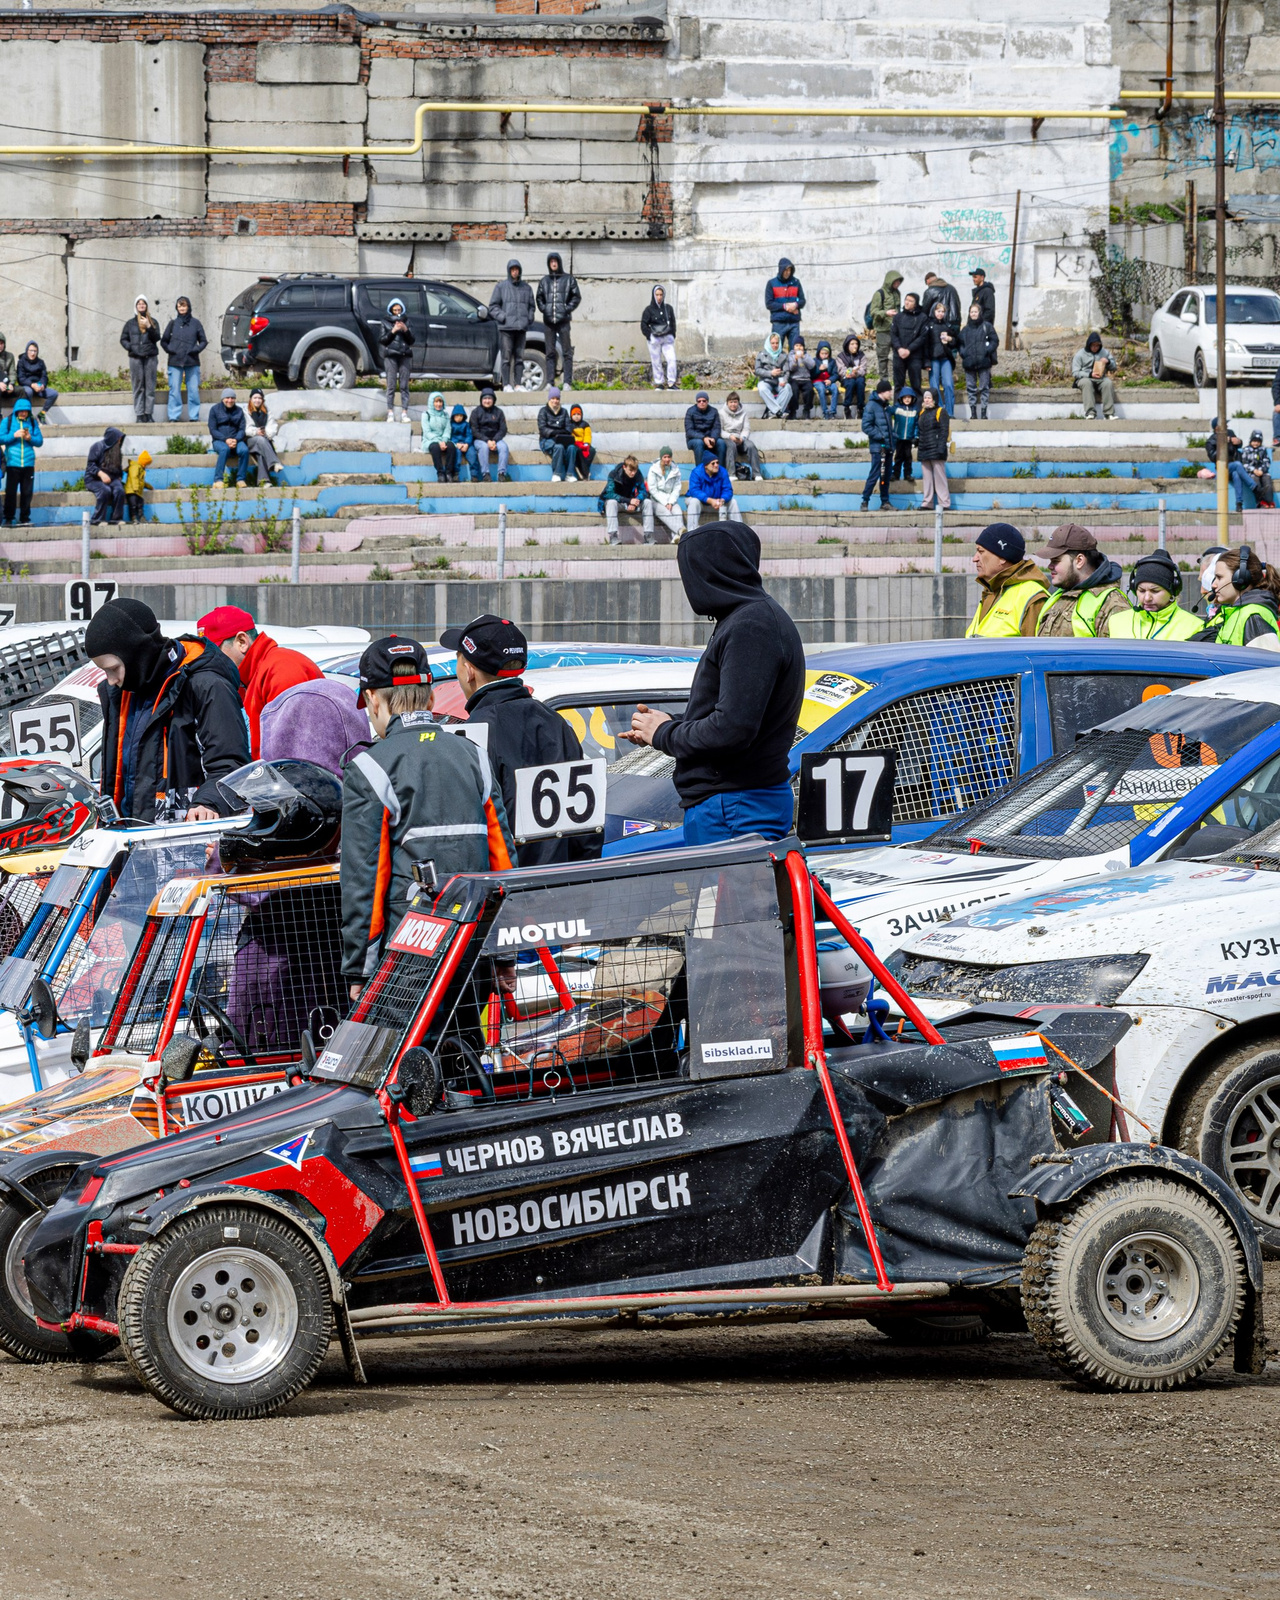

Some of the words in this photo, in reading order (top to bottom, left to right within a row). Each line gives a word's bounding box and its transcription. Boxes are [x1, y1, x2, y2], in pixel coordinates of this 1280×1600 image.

[20, 714, 76, 756] 55
[531, 764, 596, 829] 65
[812, 756, 885, 832] 17
[1119, 776, 1205, 796] Анищен
[394, 918, 446, 951] MOTUL
[497, 918, 591, 947] MOTUL
[704, 1045, 771, 1058] sibsklad.ru
[446, 1135, 543, 1173] ЧЕРНОВ
[552, 1113, 684, 1157] ВЯЧЕСЛАВ
[451, 1172, 692, 1246] НОВОСИБИРСК
